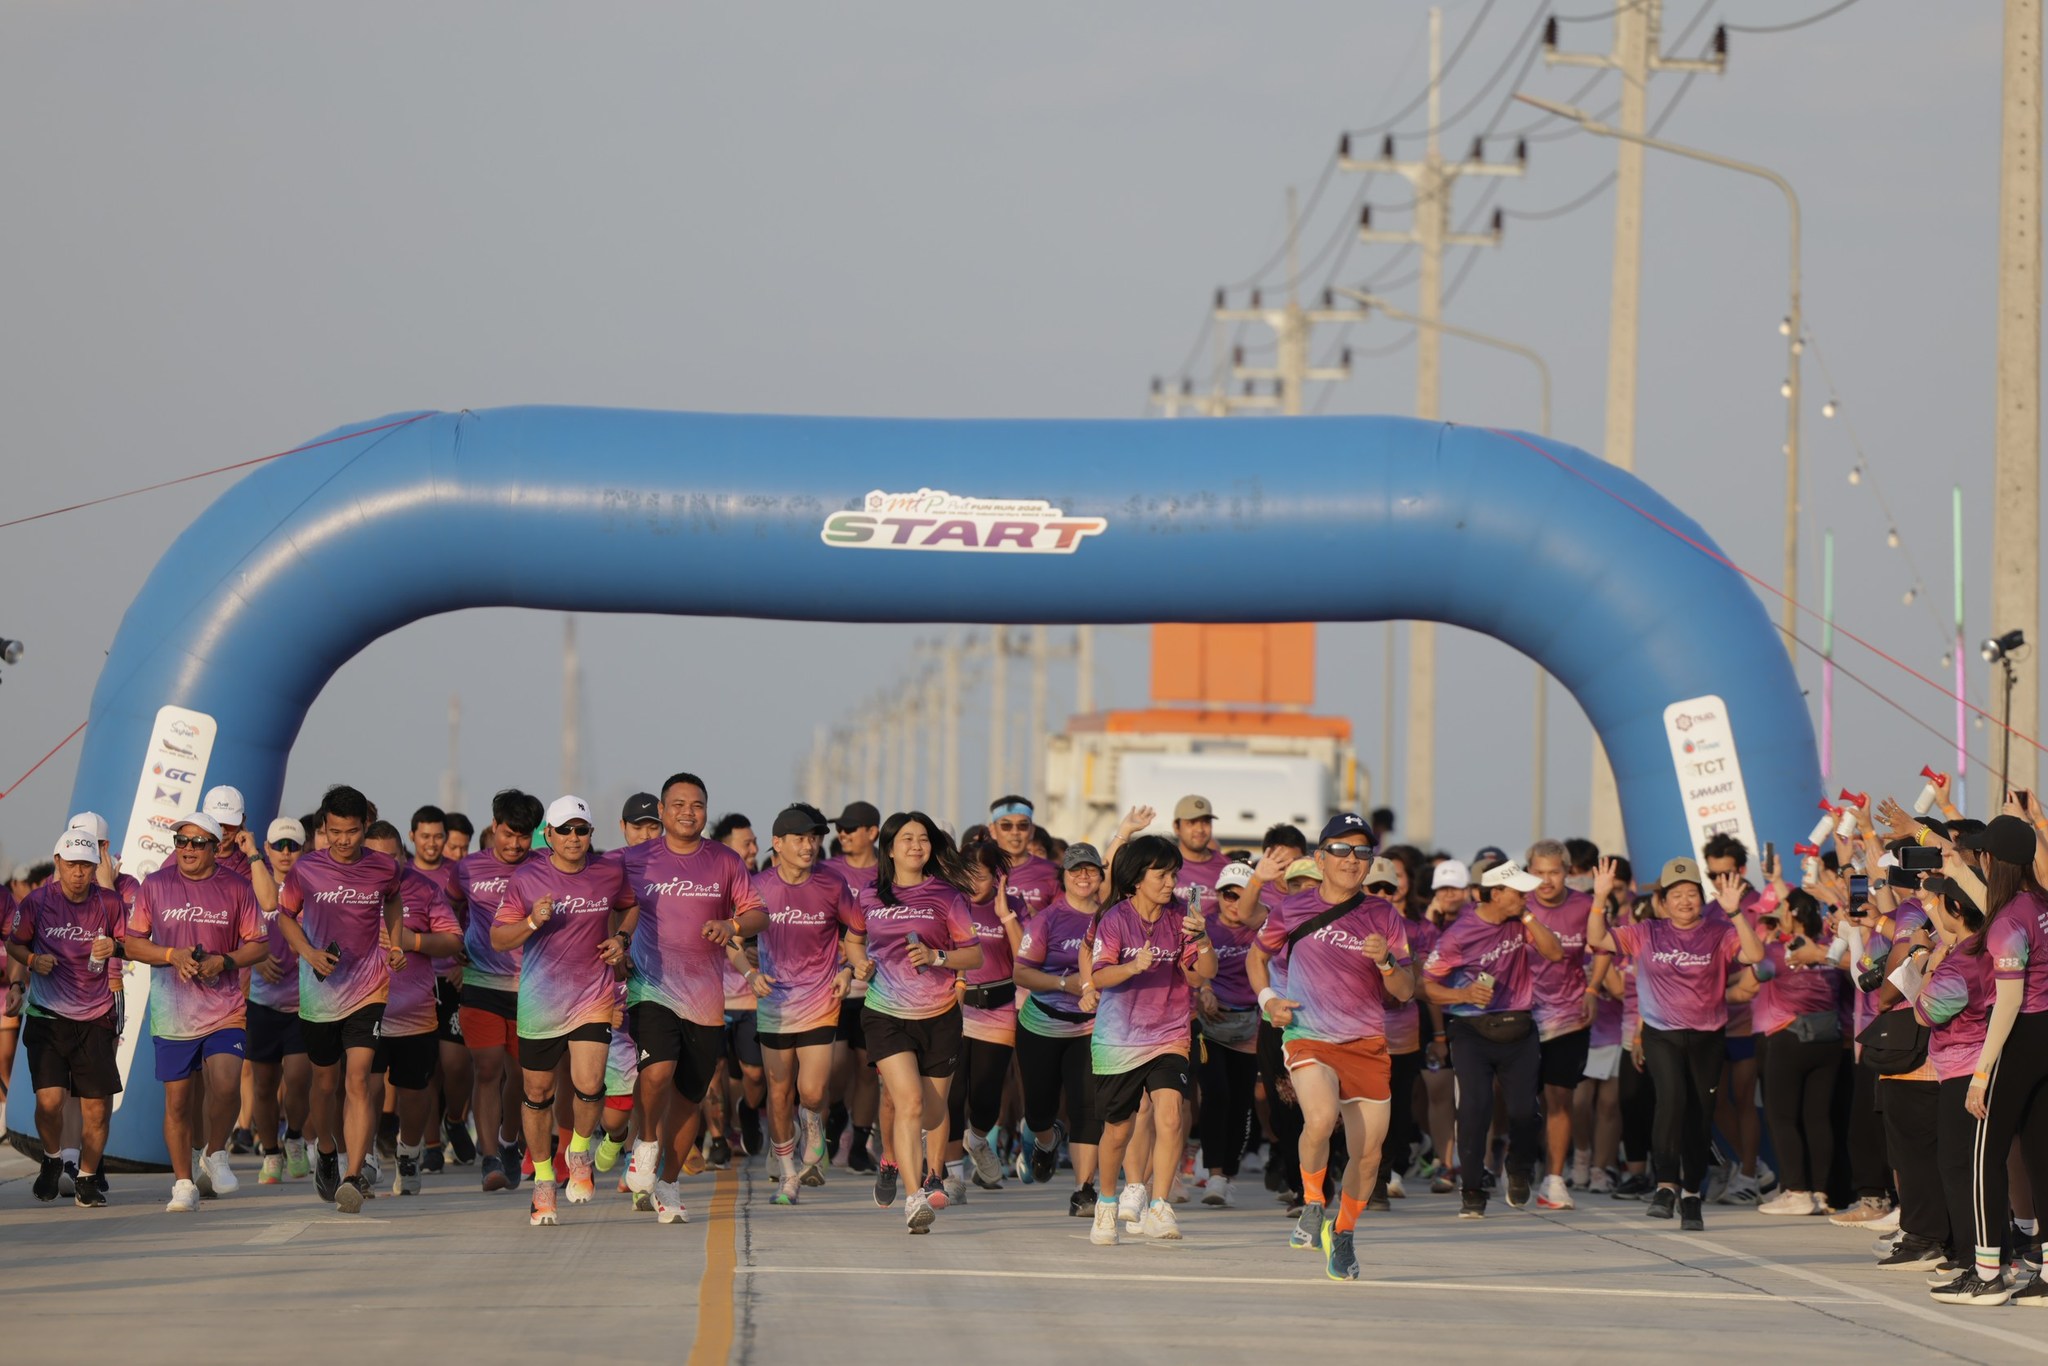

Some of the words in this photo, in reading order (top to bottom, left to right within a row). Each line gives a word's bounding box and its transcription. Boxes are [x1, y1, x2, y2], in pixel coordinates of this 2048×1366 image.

[825, 515, 1101, 549] START
[1693, 757, 1725, 776] TCT
[165, 767, 197, 784] GC
[1711, 801, 1736, 814] SCG
[141, 839, 173, 855] GPSC
